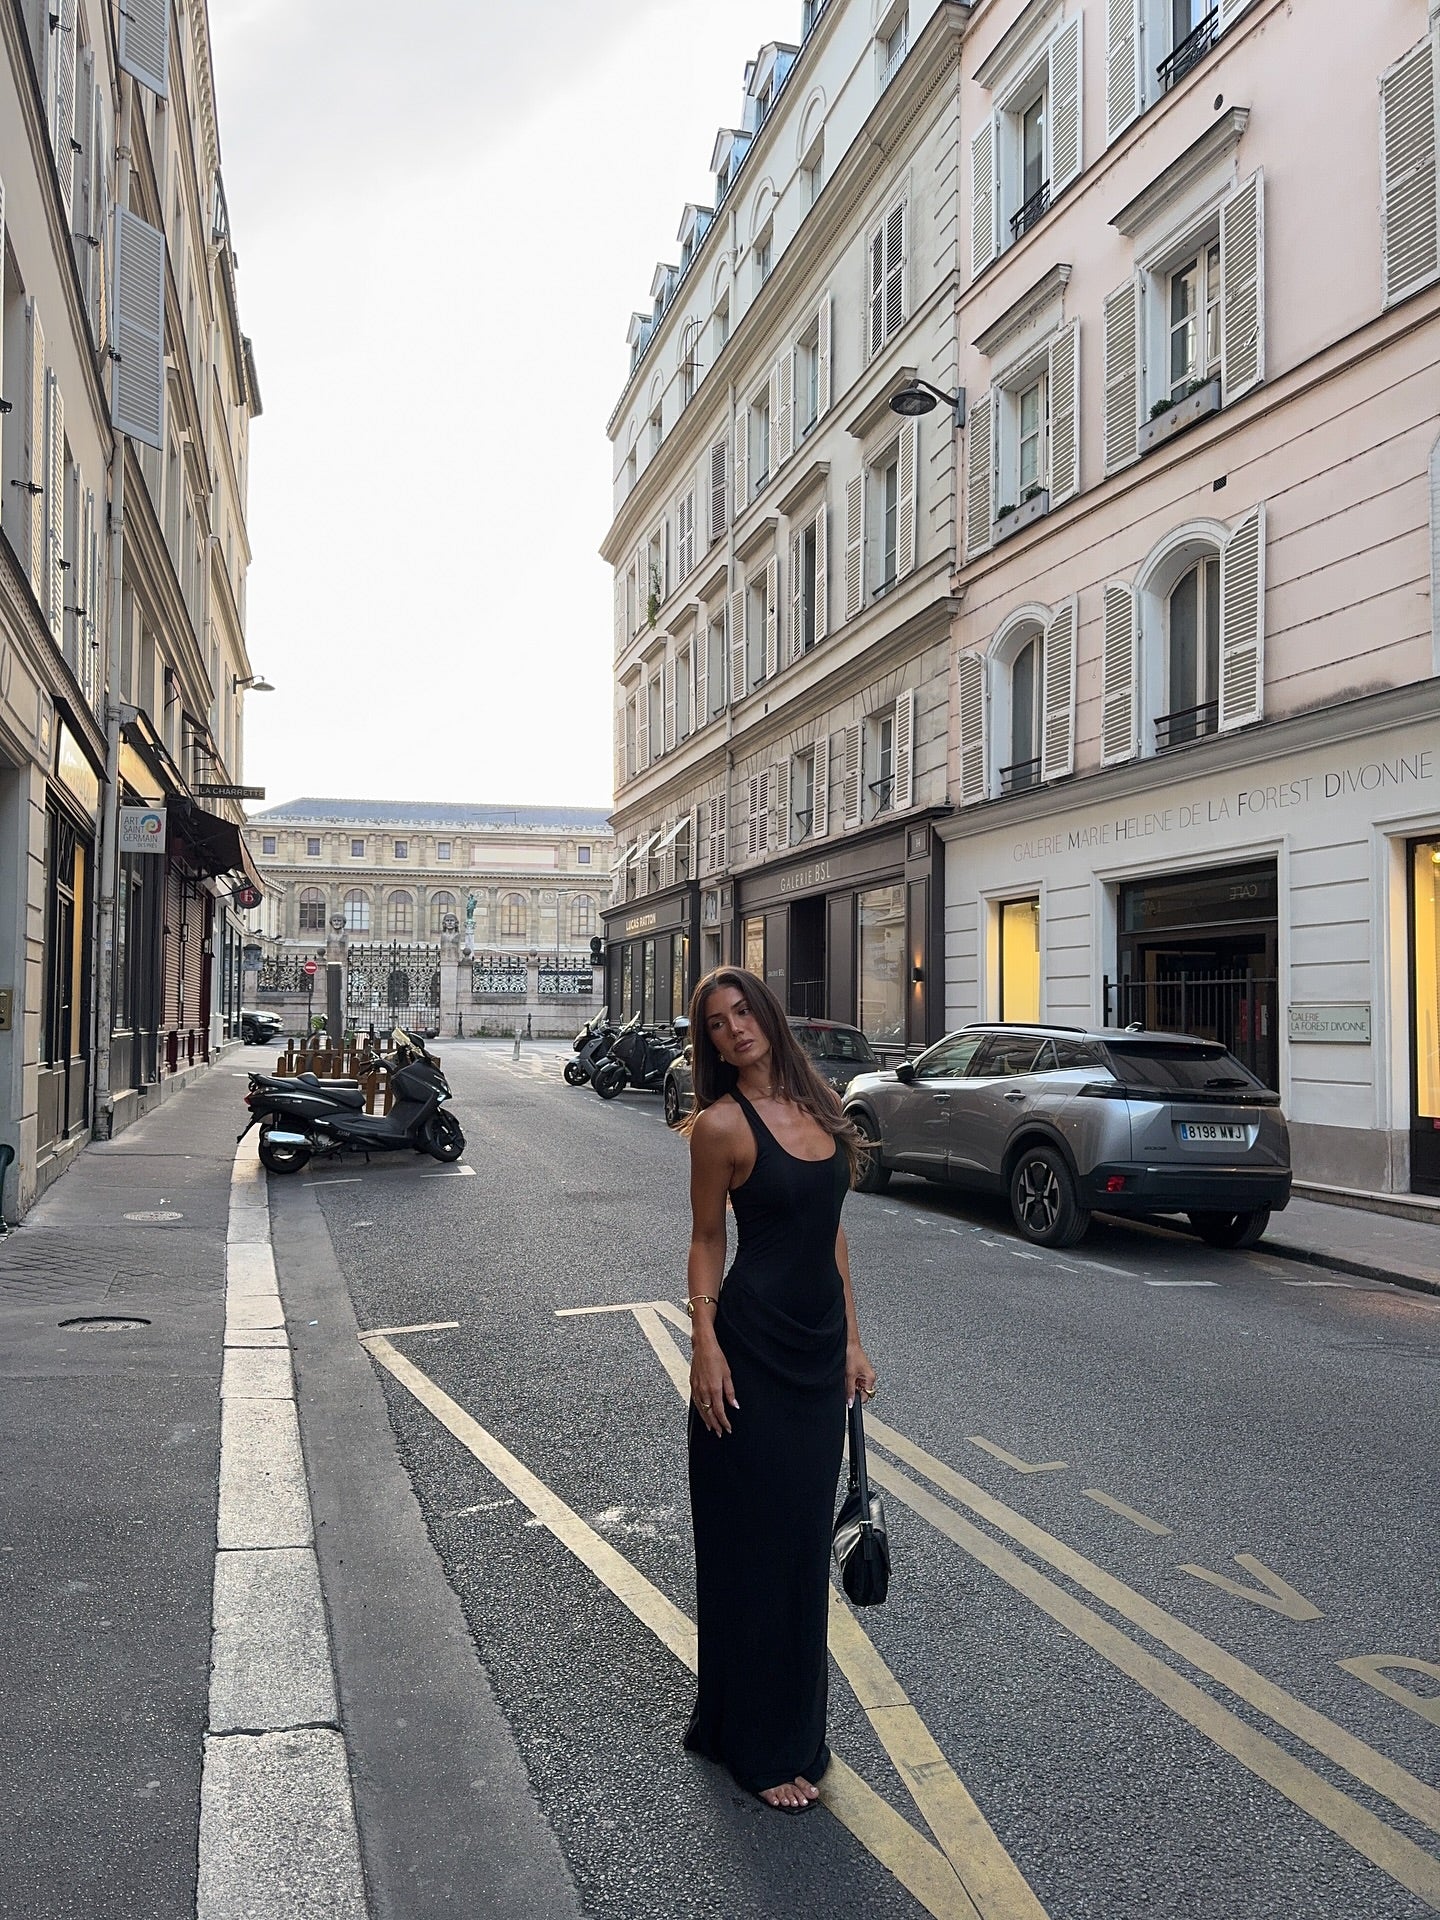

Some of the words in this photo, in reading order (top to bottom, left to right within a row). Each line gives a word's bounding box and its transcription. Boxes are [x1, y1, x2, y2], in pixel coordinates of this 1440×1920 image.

[213, 788, 264, 797] CHARRETTE
[1013, 834, 1063, 862] GALERIE
[1067, 823, 1110, 850] MARIE
[1115, 808, 1173, 840] HELENE
[1178, 802, 1201, 828] DE
[1208, 792, 1231, 822] LA
[1237, 777, 1313, 817] FOREST
[1324, 751, 1433, 799] DIVONNE
[124, 816, 139, 825] ART
[124, 825, 145, 833] SAINT
[123, 833, 158, 842] GERMAIN
[780, 870, 812, 891] GALERIE
[815, 861, 831, 882] BSL
[625, 917, 639, 931] LUCAS
[639, 912, 657, 927] RATTON
[1291, 1012, 1320, 1021] GALERIE
[1291, 1022, 1299, 1031] LA
[1301, 1022, 1329, 1031] FOREST
[1330, 1021, 1367, 1031] DIVONNE
[1189, 1126, 1217, 1139] 8198
[1220, 1126, 1241, 1139] MWJ
